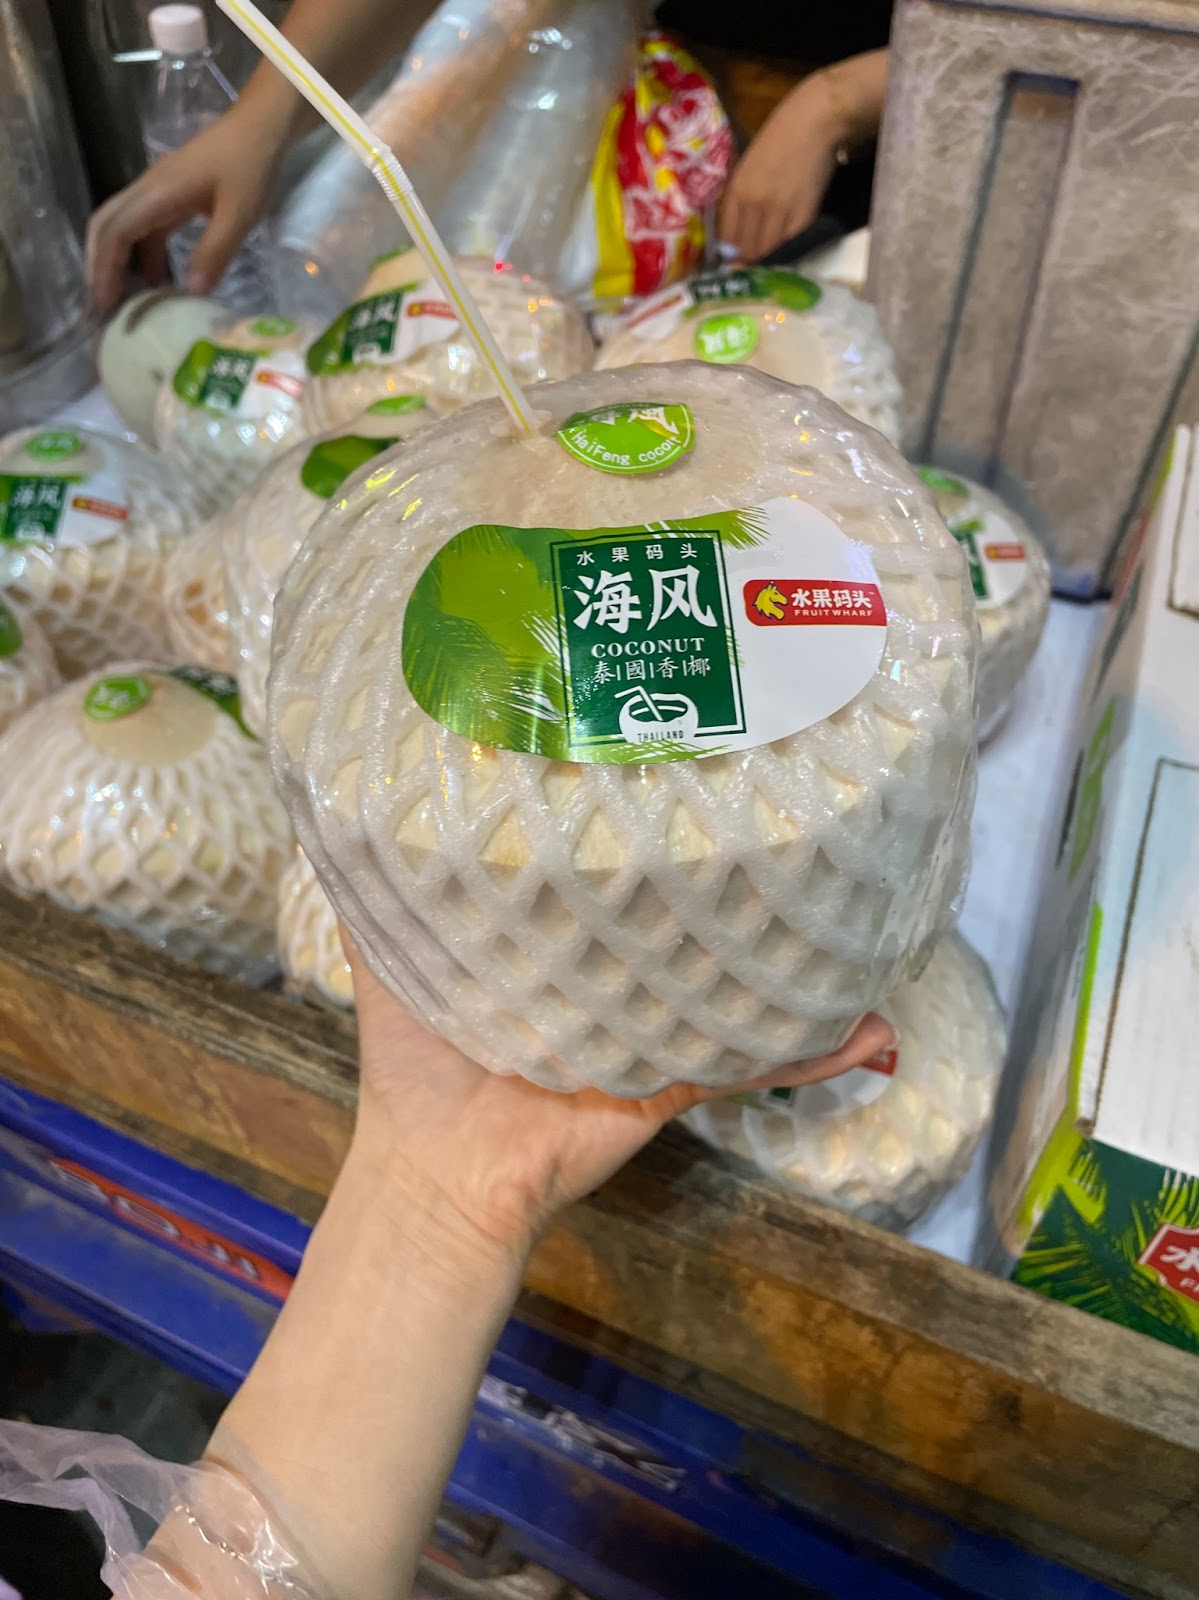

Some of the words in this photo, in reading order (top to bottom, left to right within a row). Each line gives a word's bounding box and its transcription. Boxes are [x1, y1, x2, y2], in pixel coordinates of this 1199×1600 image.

[571, 430, 631, 466] HaiFeng
[576, 543, 698, 566] 水果码头
[573, 564, 718, 634] 海风
[791, 588, 873, 608] 水果码头
[794, 609, 829, 617] FRUIT
[833, 609, 873, 617] WHARF
[591, 637, 705, 659] COCONUT
[637, 730, 684, 743] THAILAND
